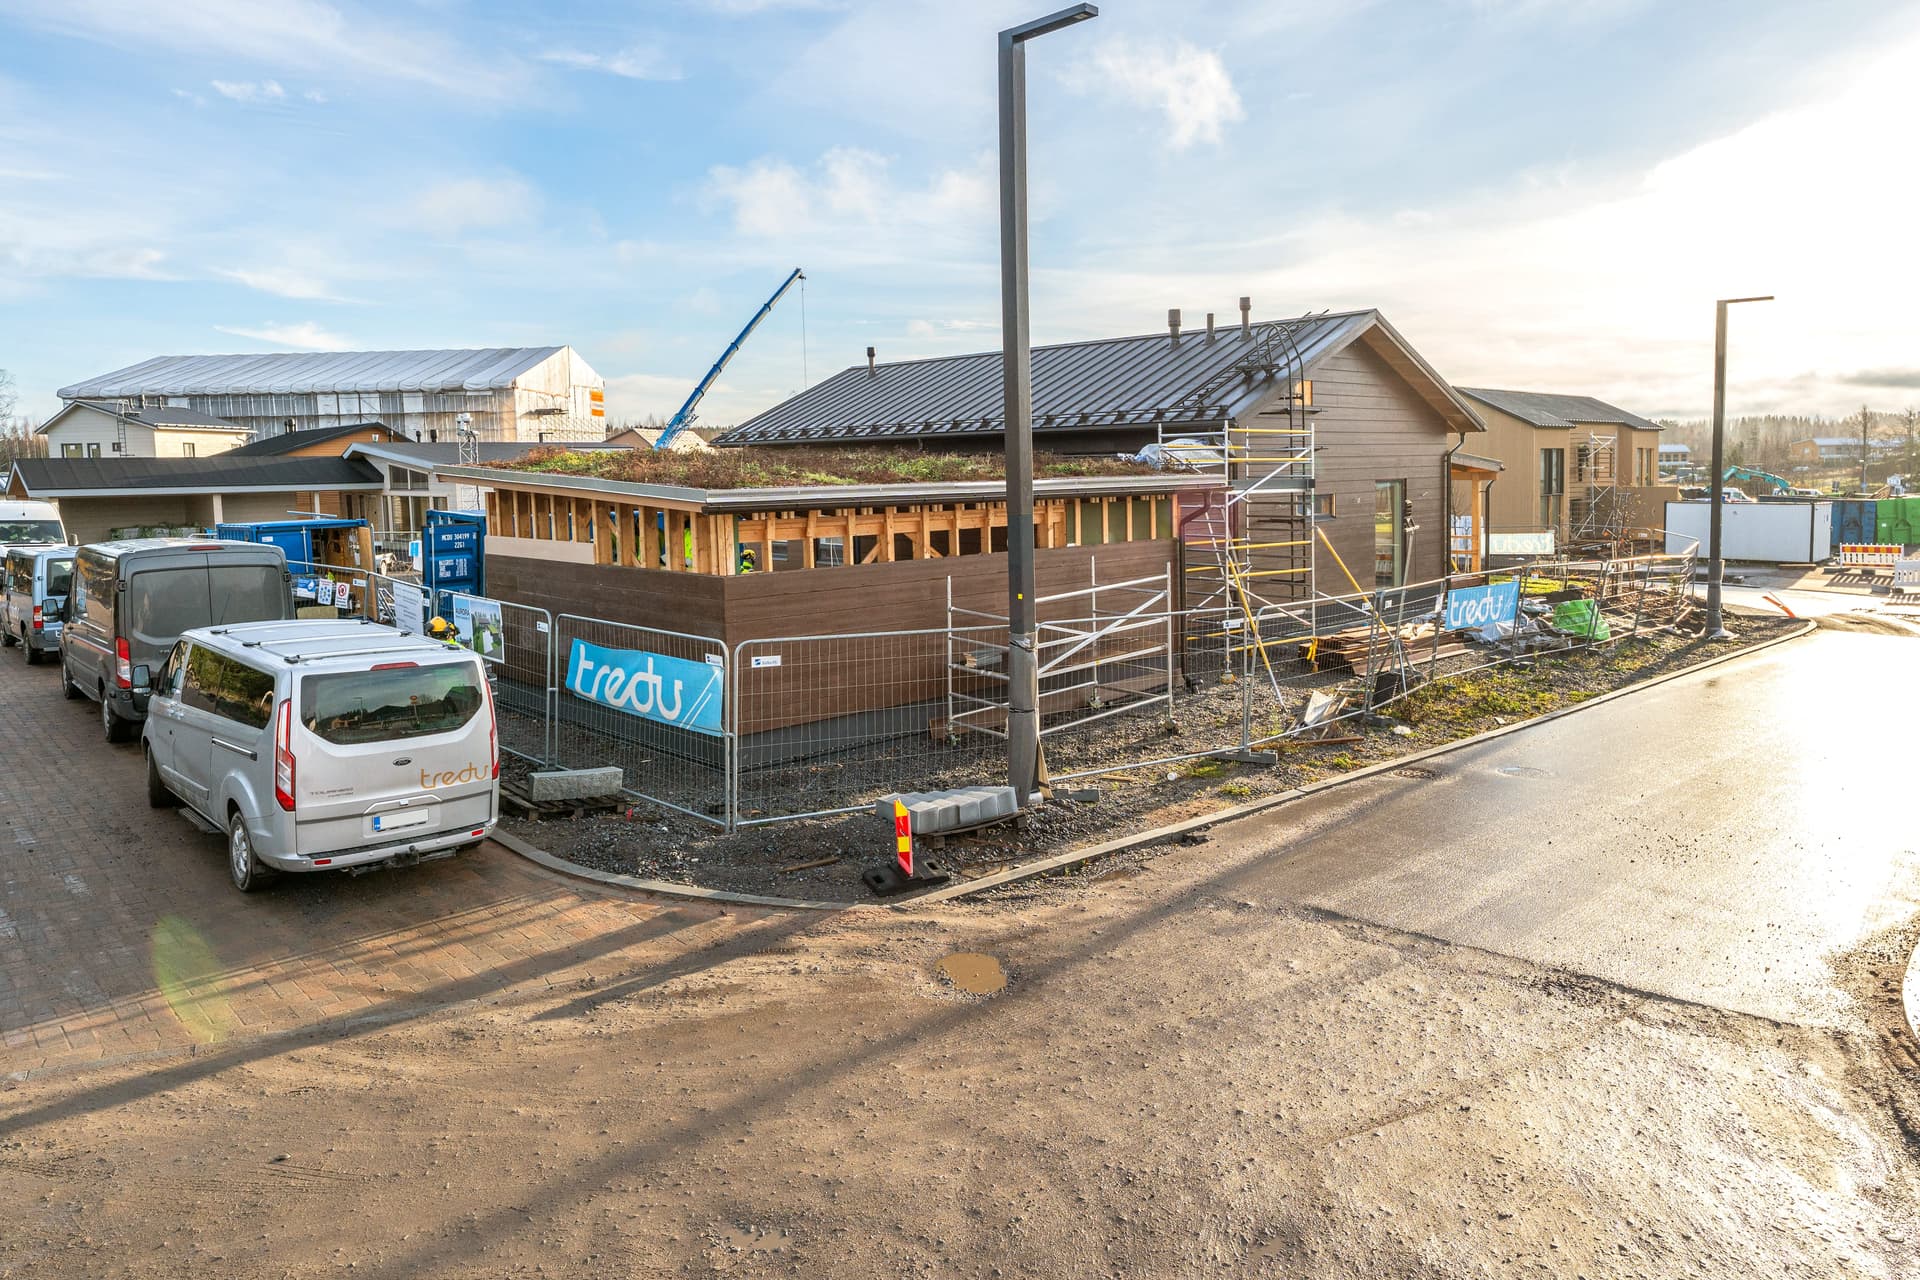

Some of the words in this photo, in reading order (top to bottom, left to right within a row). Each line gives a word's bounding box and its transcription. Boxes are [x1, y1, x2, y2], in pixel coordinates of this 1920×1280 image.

[1450, 588, 1503, 627] tredu
[574, 643, 683, 721] tredu
[420, 761, 488, 789] tredu
